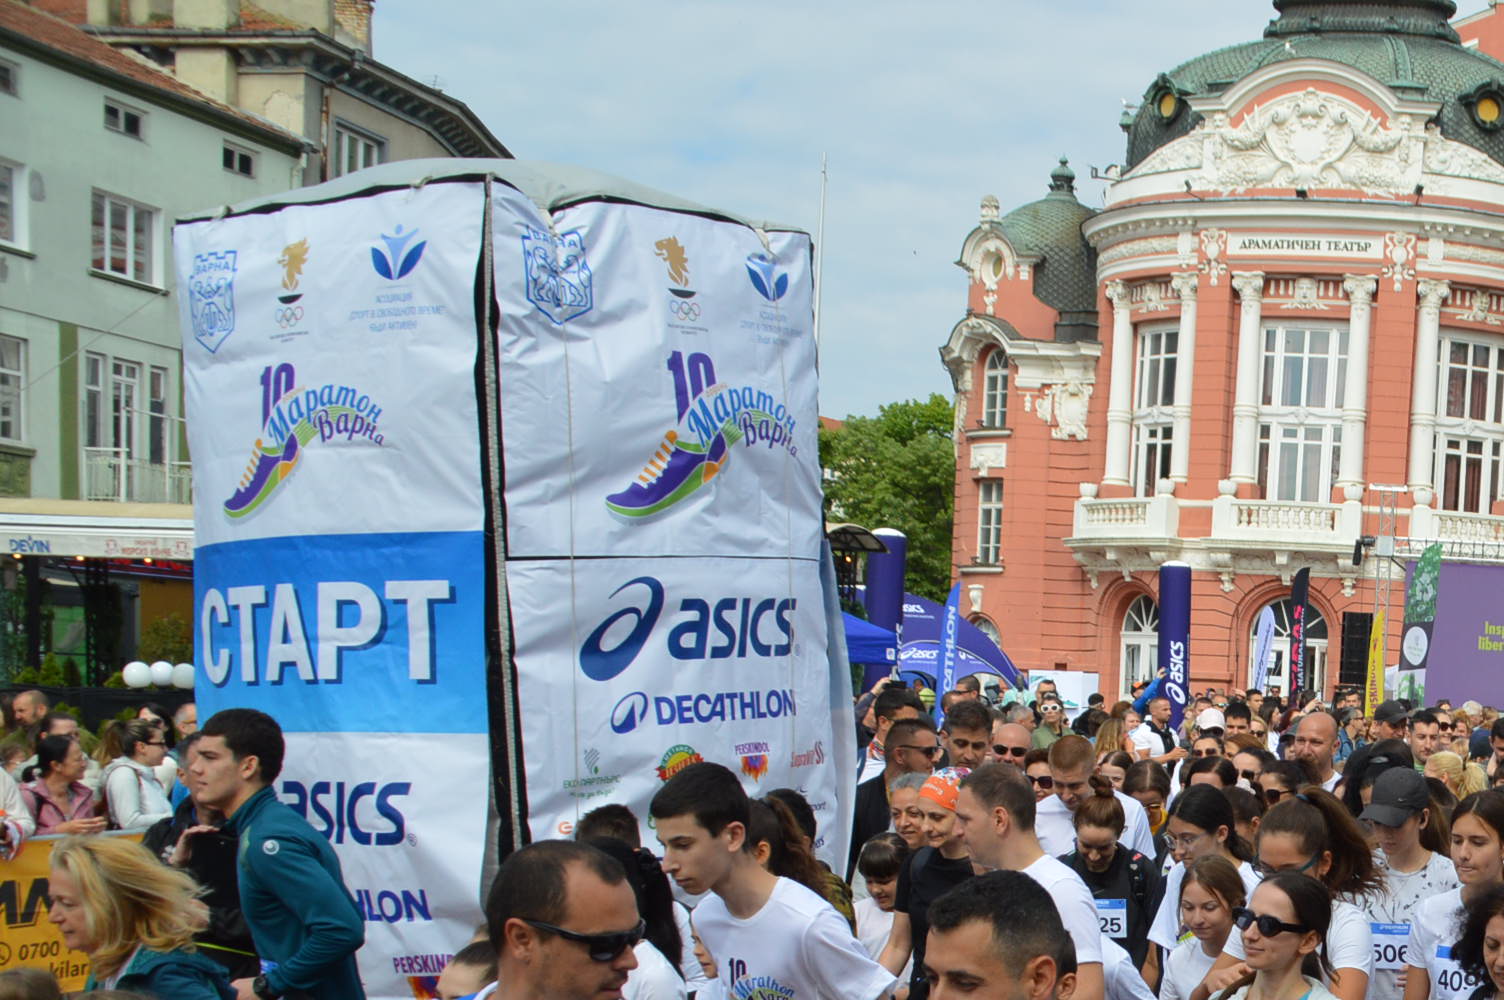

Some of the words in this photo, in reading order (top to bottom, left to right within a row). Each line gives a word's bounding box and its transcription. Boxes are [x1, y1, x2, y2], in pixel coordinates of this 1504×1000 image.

[1239, 238, 1321, 251] ДРАМАТИЧЕН
[1326, 240, 1372, 252] ТЕАТЪР
[260, 362, 295, 433] 10
[666, 350, 717, 425] 10
[268, 384, 382, 449] Маратон
[312, 408, 385, 447] Варна
[687, 386, 796, 449] Маратон
[9, 536, 50, 553] DEVIN
[202, 579, 453, 687] СТАРТ
[943, 605, 957, 692] CATHLON
[654, 689, 796, 726] DECATHLON
[1100, 917, 1122, 933] 25
[18, 940, 61, 960] 0700
[393, 953, 454, 974] PERSKIN
[1373, 944, 1409, 963] 506
